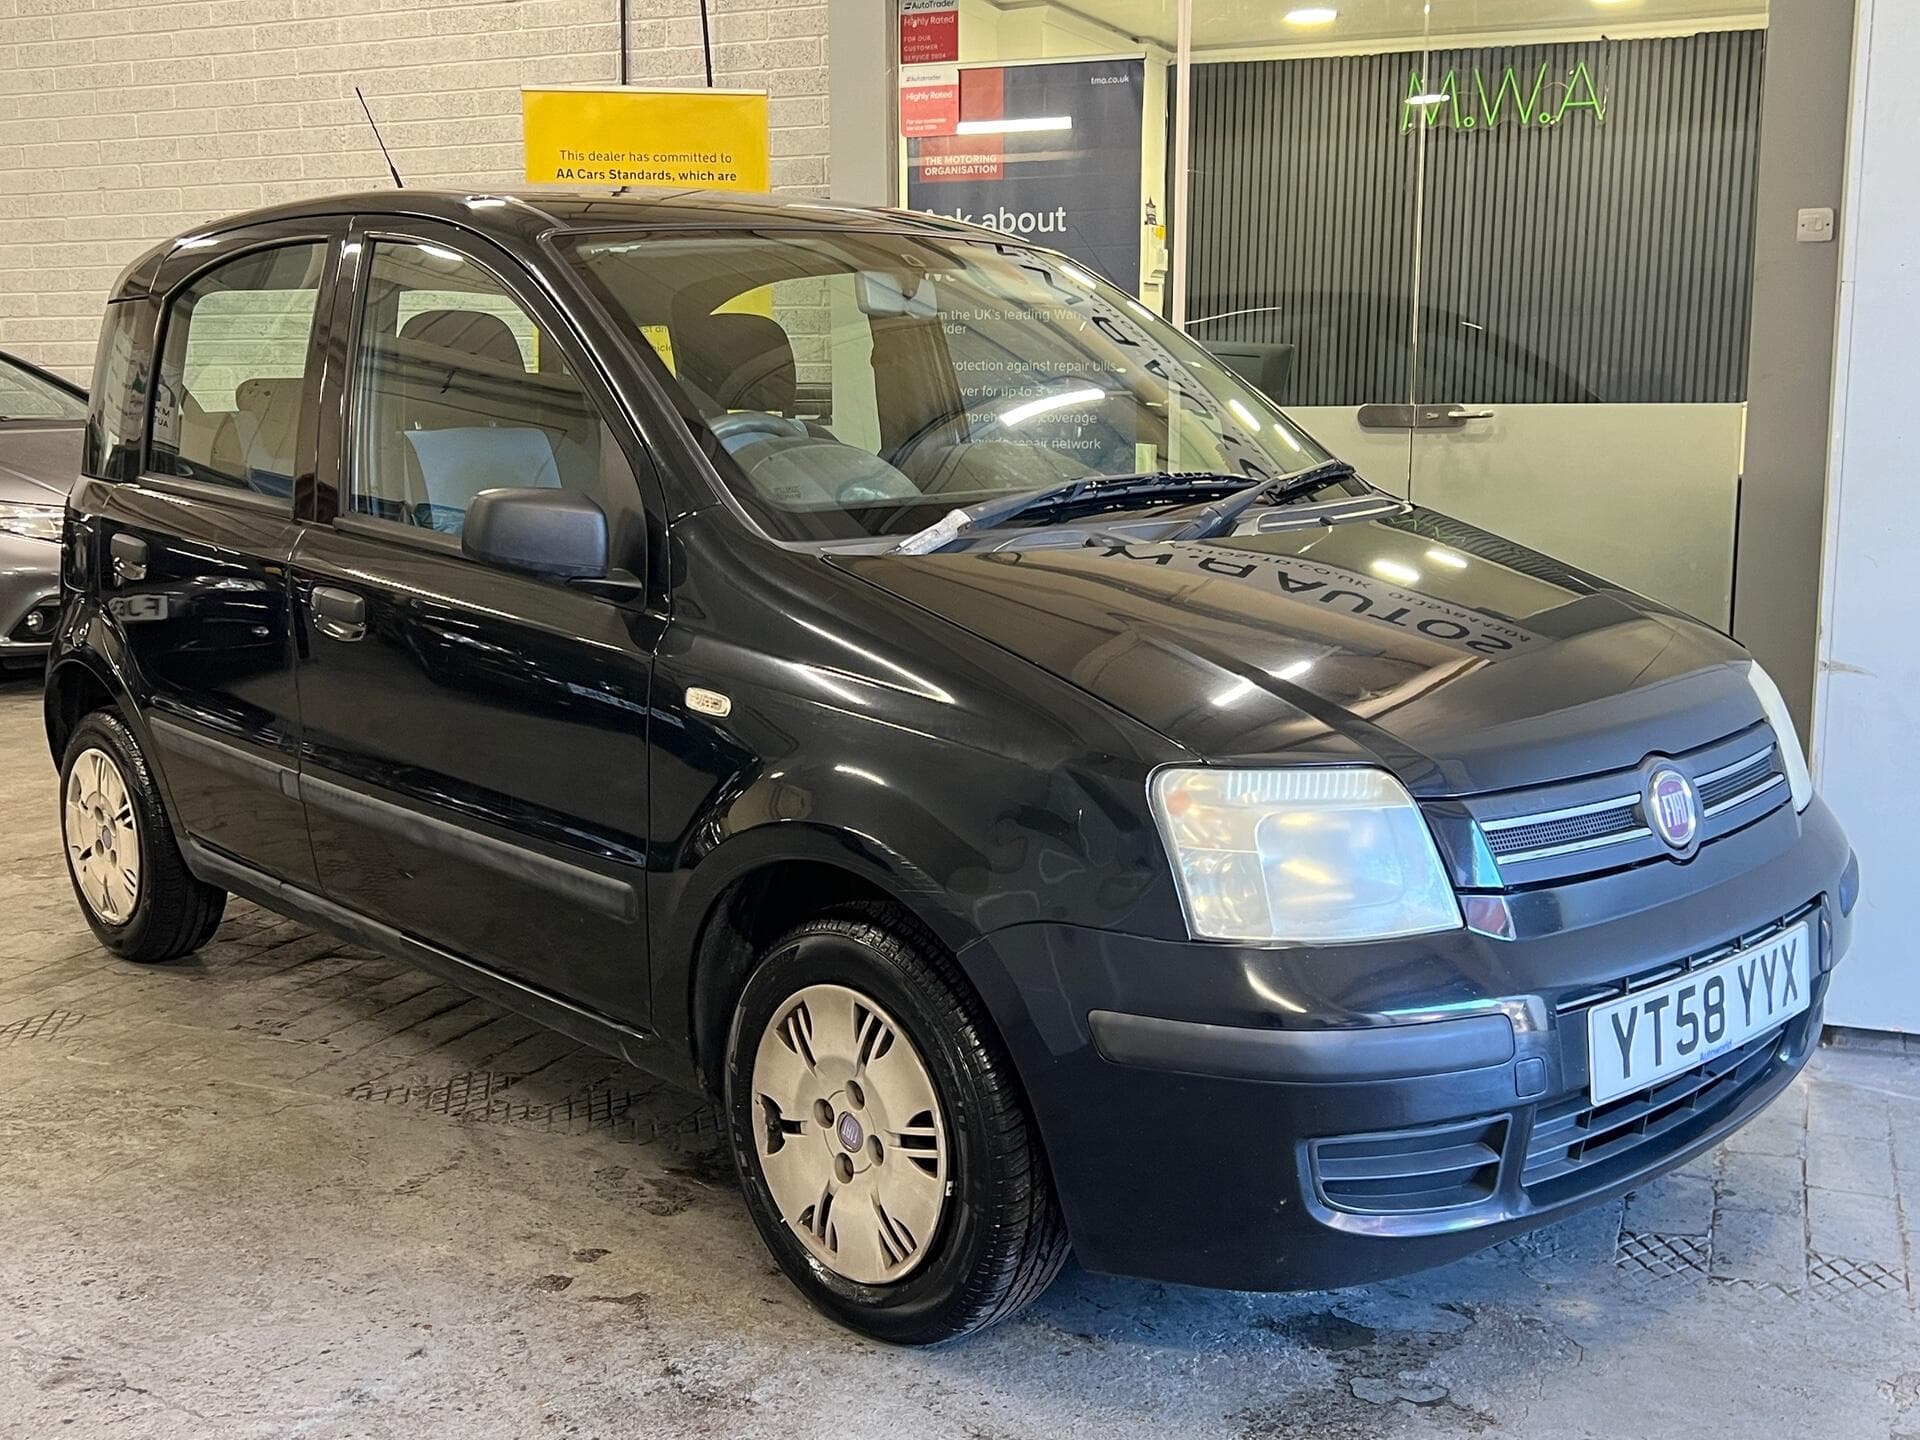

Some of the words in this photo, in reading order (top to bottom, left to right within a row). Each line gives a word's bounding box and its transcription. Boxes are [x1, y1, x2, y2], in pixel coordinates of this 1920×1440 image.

[911, 0, 955, 9] AutoTrader
[904, 16, 929, 28] Highly
[930, 15, 955, 25] Rated
[903, 44, 938, 52] CUSTOMER
[905, 92, 929, 102] Highly
[929, 90, 953, 100] Rated
[559, 150, 584, 161] This
[588, 151, 625, 163] dealer
[629, 152, 649, 163] has
[653, 153, 717, 164] committed
[721, 153, 732, 164] to
[925, 156, 943, 165] THE
[945, 154, 997, 165] MOTORING
[556, 168, 574, 180] AA
[577, 169, 605, 181] Cars
[608, 169, 675, 182] Standards,
[678, 171, 714, 182] which
[718, 173, 737, 182] are
[924, 165, 997, 175] ORGANISATION
[982, 206, 1067, 234] about
[951, 310, 971, 320] the
[974, 309, 1000, 320] UK's
[1004, 309, 1050, 323] leading
[1006, 361, 1050, 376] against
[1054, 361, 1089, 375] repair
[981, 387, 998, 397] for
[1001, 387, 1016, 400] up
[1018, 387, 1032, 397] to
[1035, 387, 1043, 397] 3
[1038, 413, 1097, 425] coverage
[1051, 437, 1101, 449] network
[1661, 789, 1689, 828] FIAT
[1611, 975, 1725, 1079] YT58
[1737, 938, 1798, 1027] YYX
